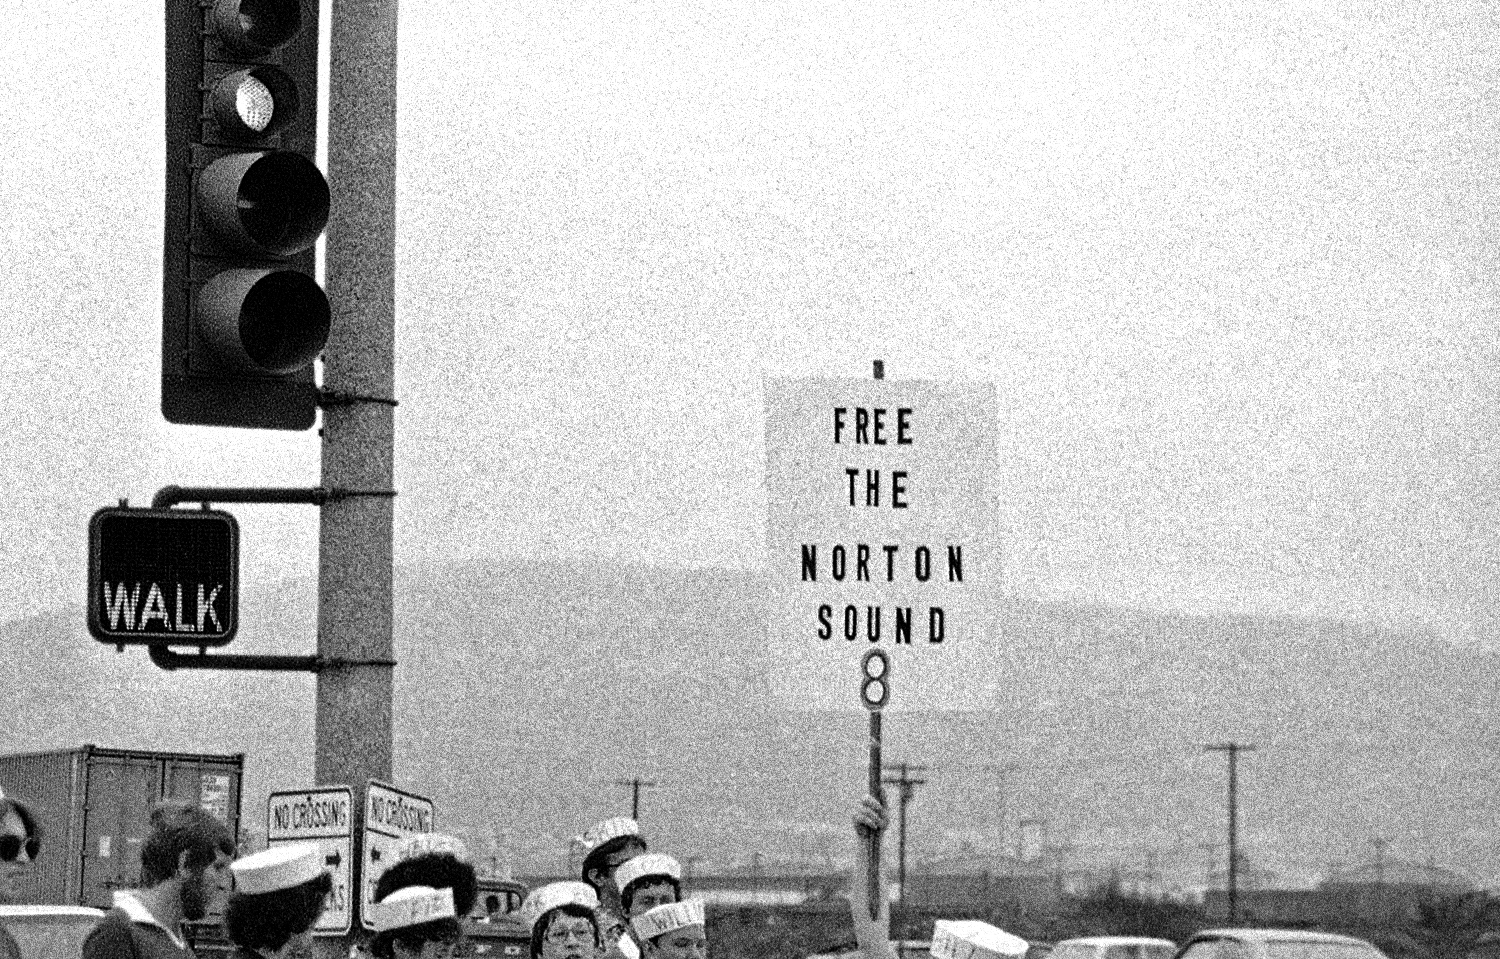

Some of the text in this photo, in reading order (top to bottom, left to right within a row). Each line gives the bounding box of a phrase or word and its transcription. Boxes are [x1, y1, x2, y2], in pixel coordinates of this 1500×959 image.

[834, 407, 913, 446] FREE
[845, 468, 908, 509] THE
[801, 544, 964, 582] NORTON
[103, 581, 223, 632] WALK
[817, 604, 946, 645] SOUND
[860, 648, 891, 711] 8
[274, 800, 347, 829] NO CROSSING
[371, 795, 430, 834] NO CROSSING
